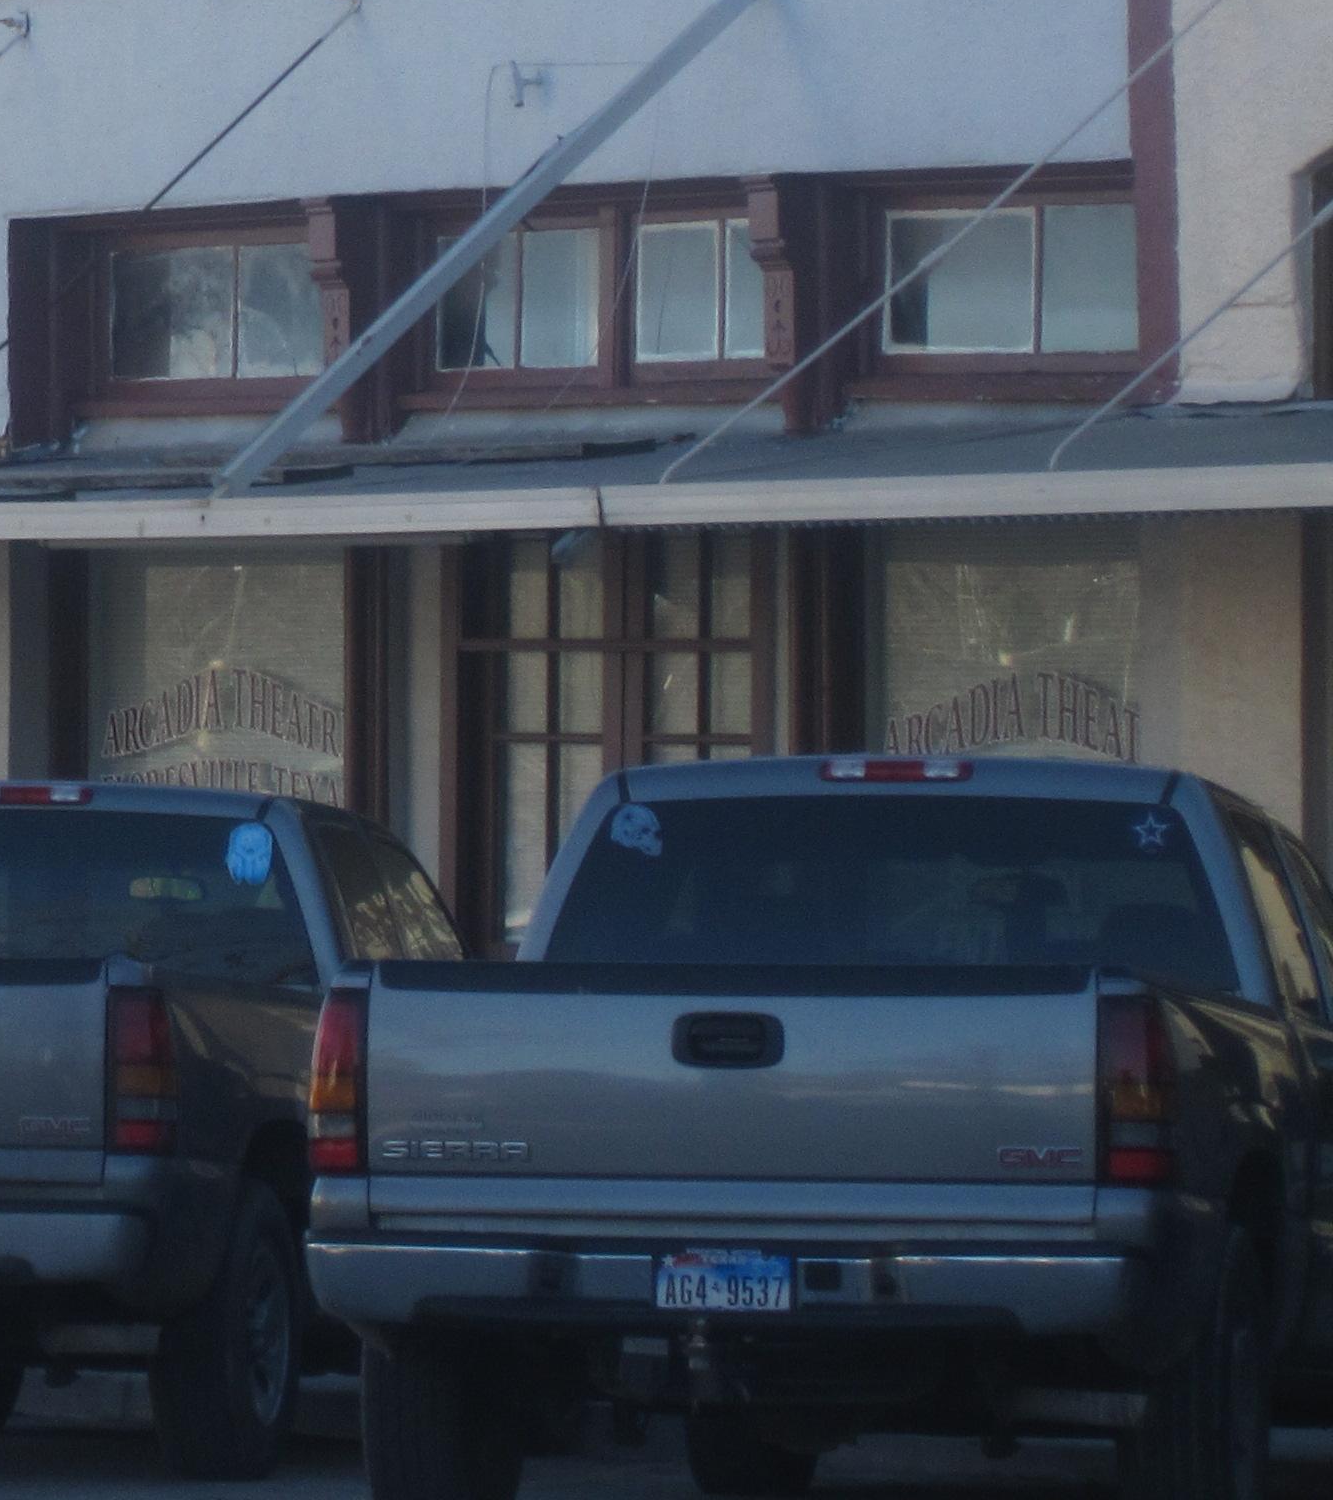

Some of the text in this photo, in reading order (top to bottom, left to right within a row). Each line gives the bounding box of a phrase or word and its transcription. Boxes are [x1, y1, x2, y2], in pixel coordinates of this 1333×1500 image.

[102, 668, 343, 758] ARCADIA THEATR
[884, 672, 1025, 755] ARCADIA
[383, 1140, 529, 1159] SIERRA
[997, 1146, 1083, 1168] GMC
